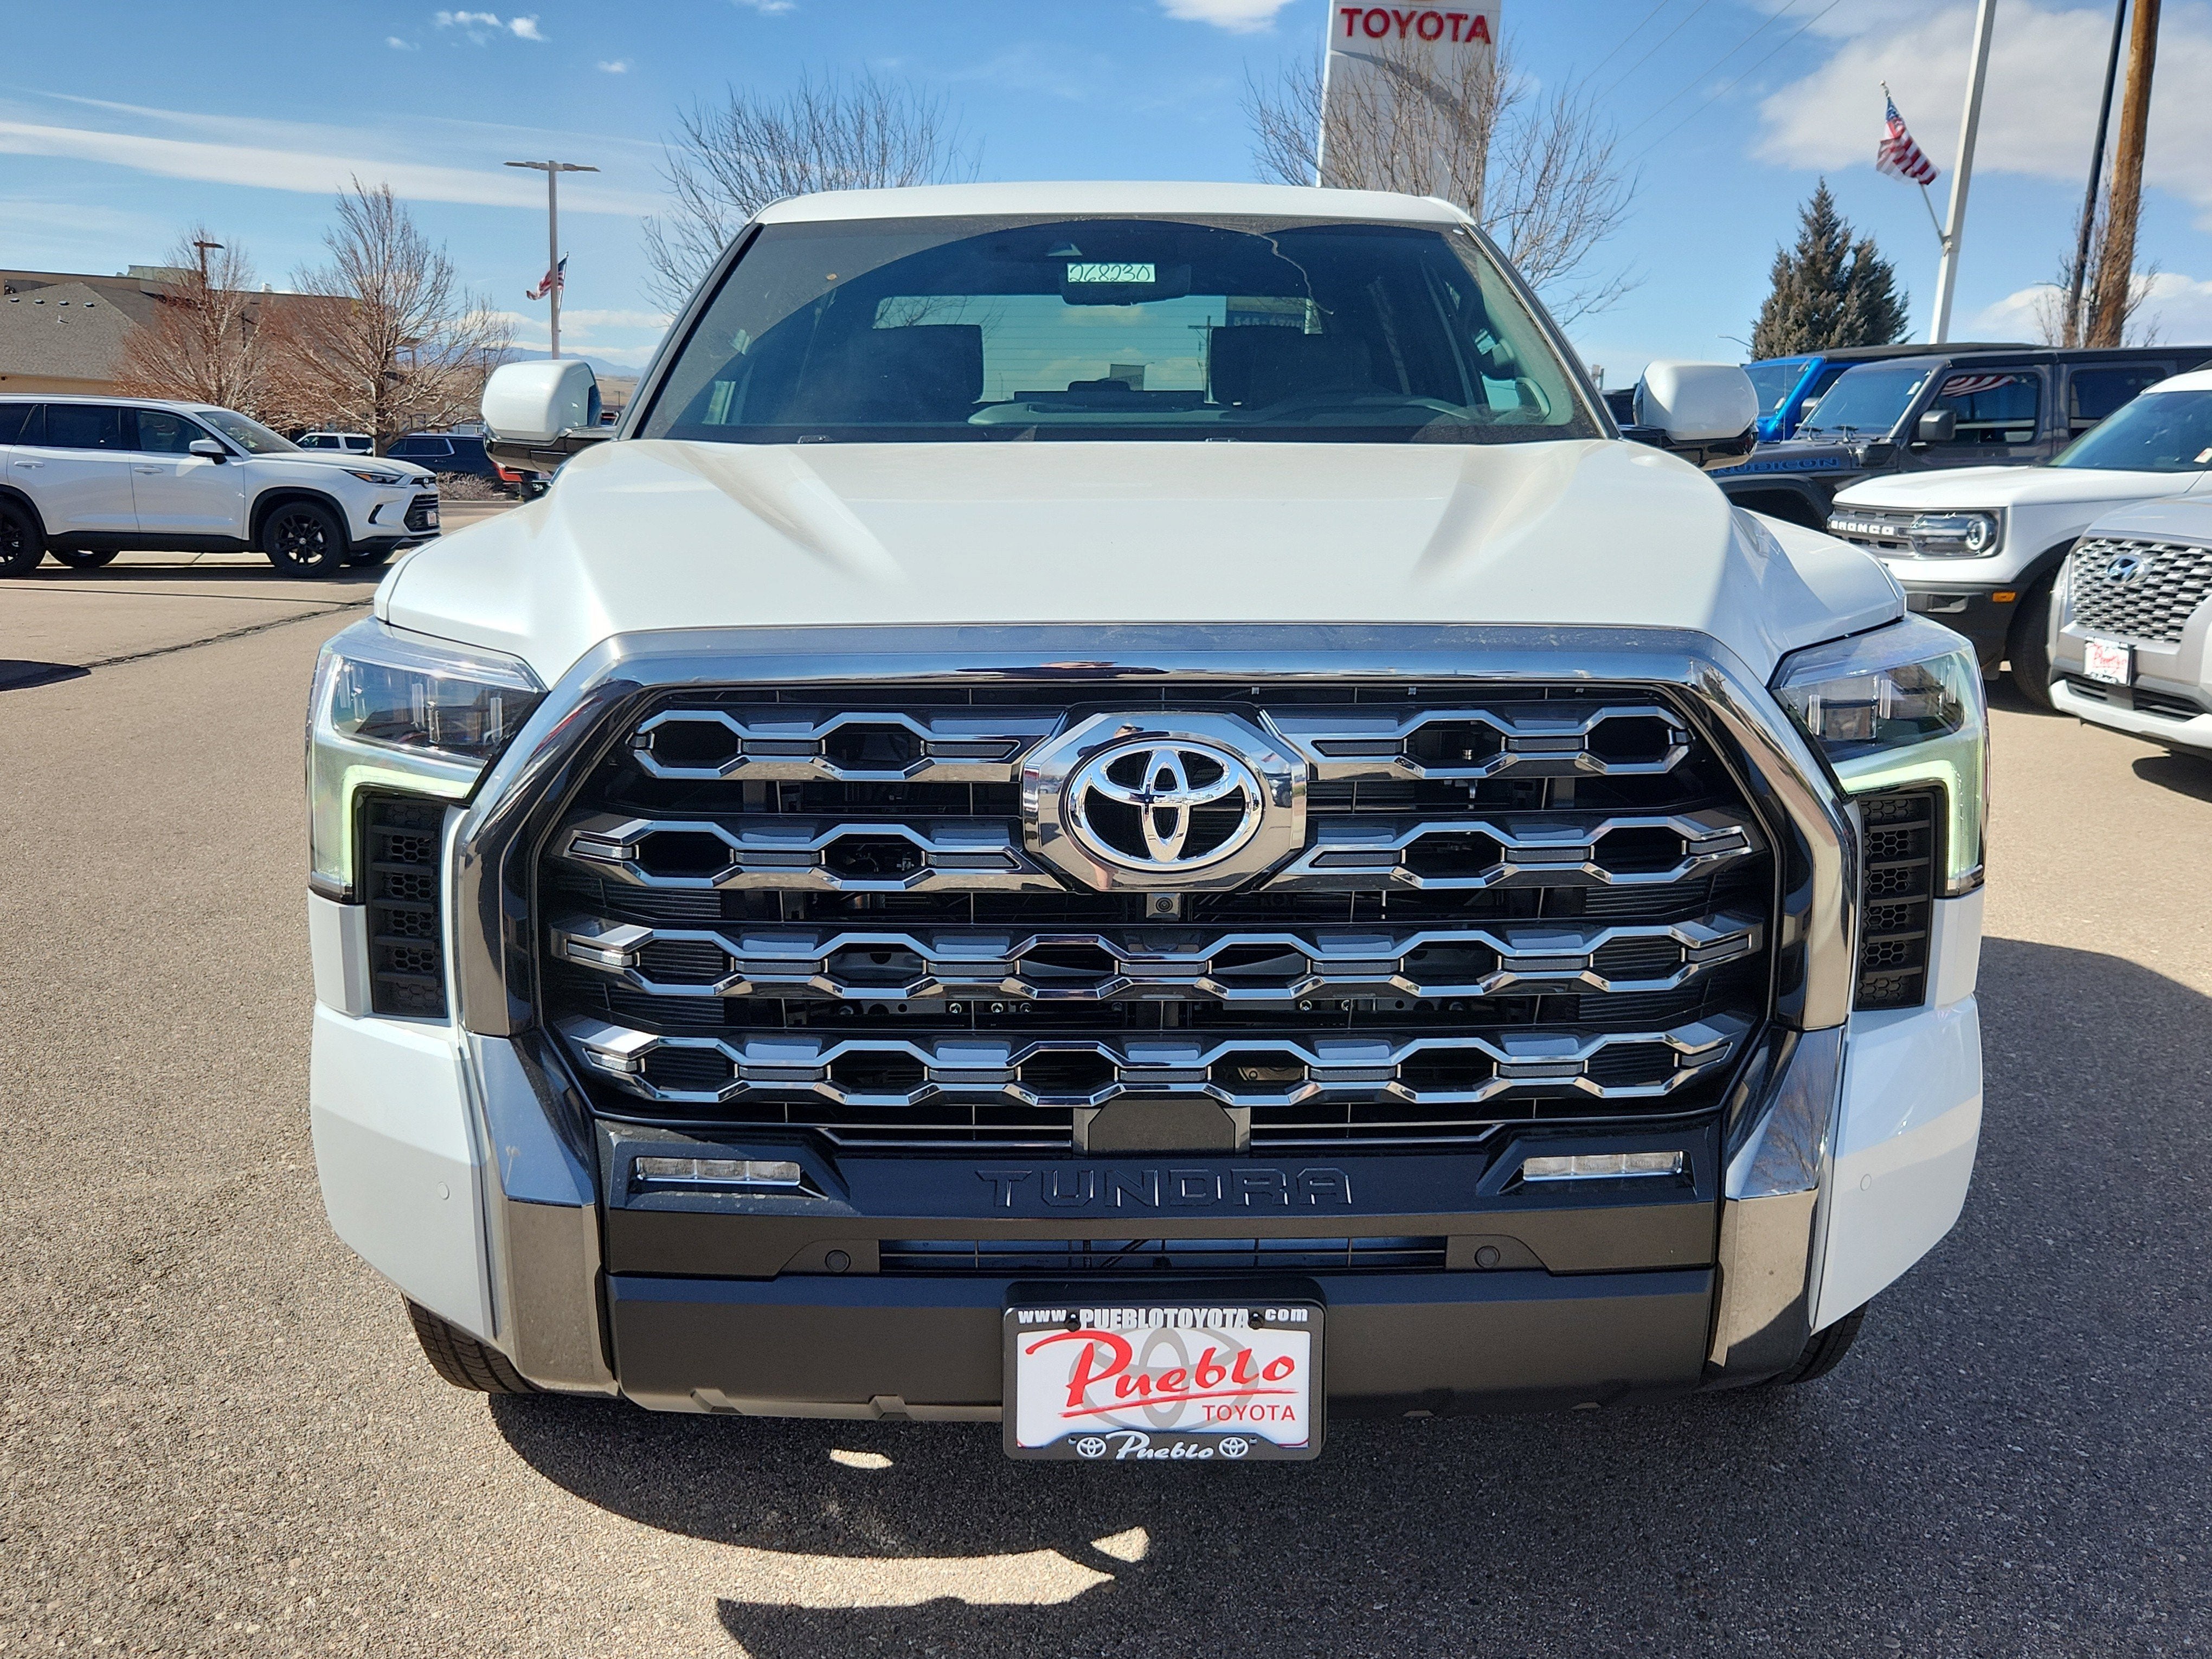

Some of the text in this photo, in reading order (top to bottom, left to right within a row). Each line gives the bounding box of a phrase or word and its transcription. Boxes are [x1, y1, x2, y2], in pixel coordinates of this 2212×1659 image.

[1340, 8, 1491, 44] TOYOTA
[1070, 264, 1150, 282] 268230
[1831, 520, 1895, 536] BRONCO
[975, 1168, 1353, 1207] TUNDRA
[1018, 1308, 1308, 1329] www PUEBLOTOYOTA com
[1025, 1329, 1295, 1407] Pueblo
[1202, 1404, 1296, 1422] TOYOTA
[1105, 1430, 1214, 1460] Pueblo
